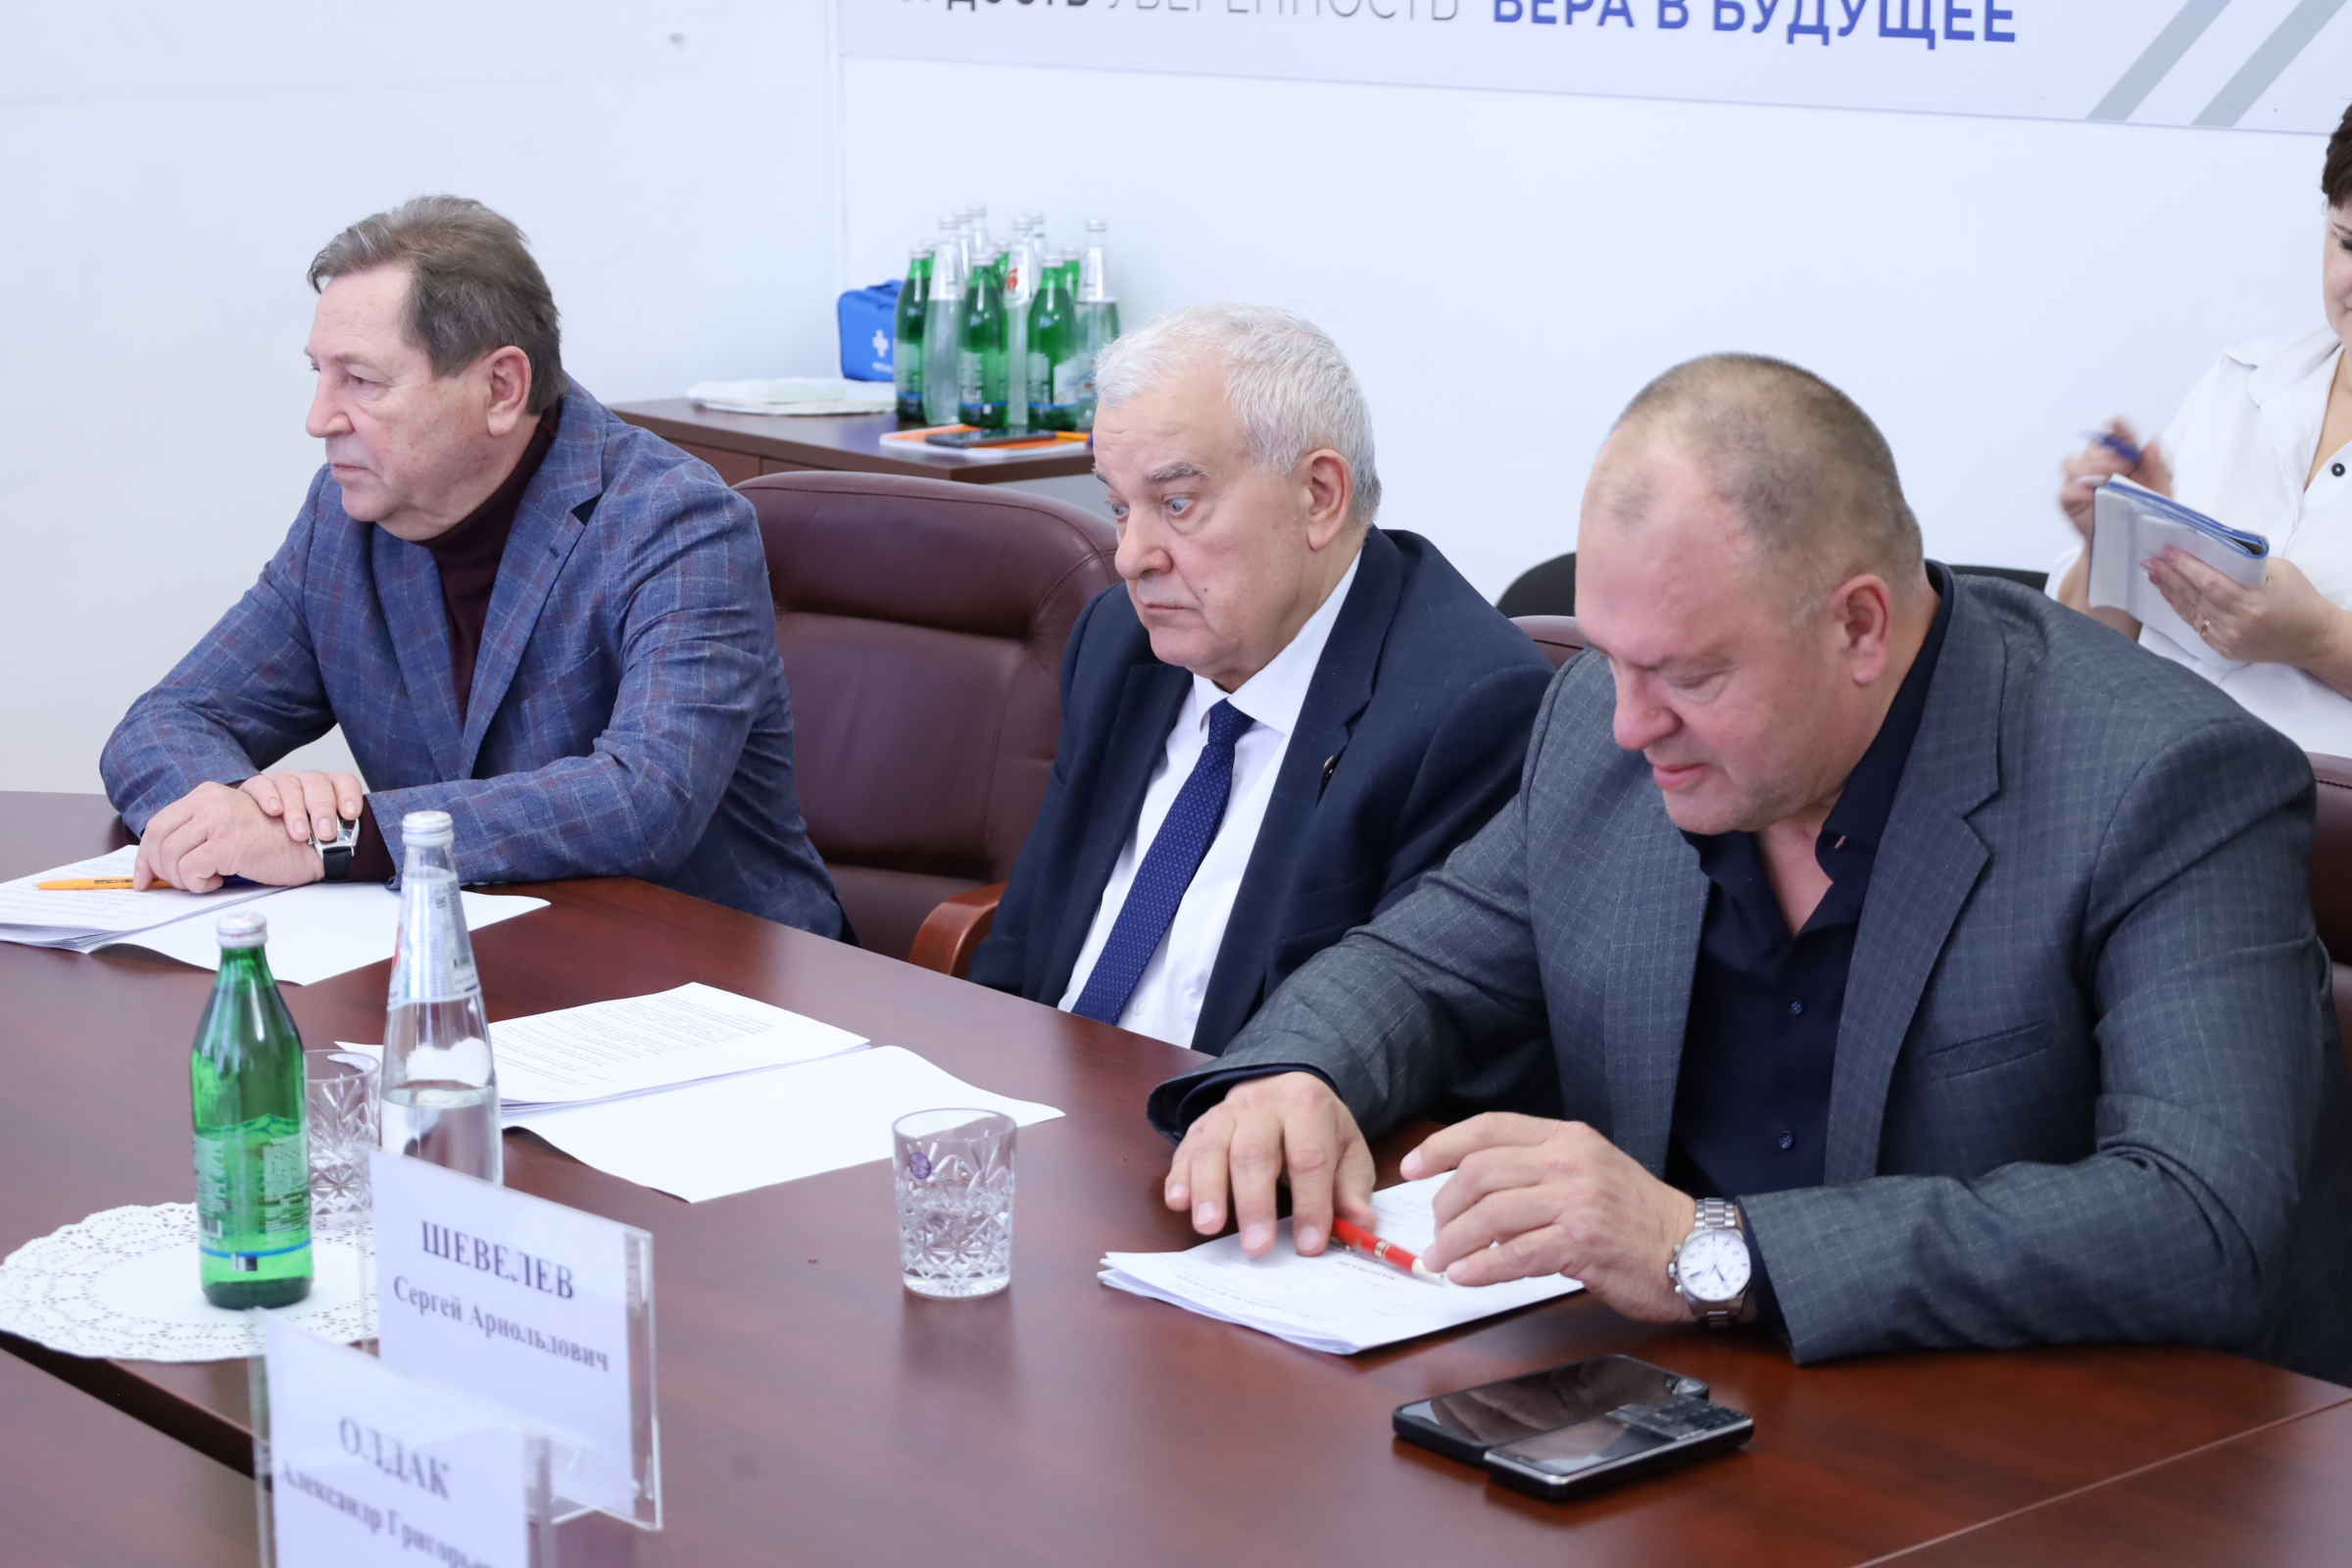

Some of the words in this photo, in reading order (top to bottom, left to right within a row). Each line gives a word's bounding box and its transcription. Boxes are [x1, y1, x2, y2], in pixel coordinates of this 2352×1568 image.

[1713, 0, 2016, 50] БУДУЩЕЕ
[420, 1220, 574, 1299] ШЕВЕЛЕВ
[393, 1275, 462, 1322] Сергей
[469, 1305, 610, 1371] Арнольдович
[388, 1509, 493, 1568] Григорь
